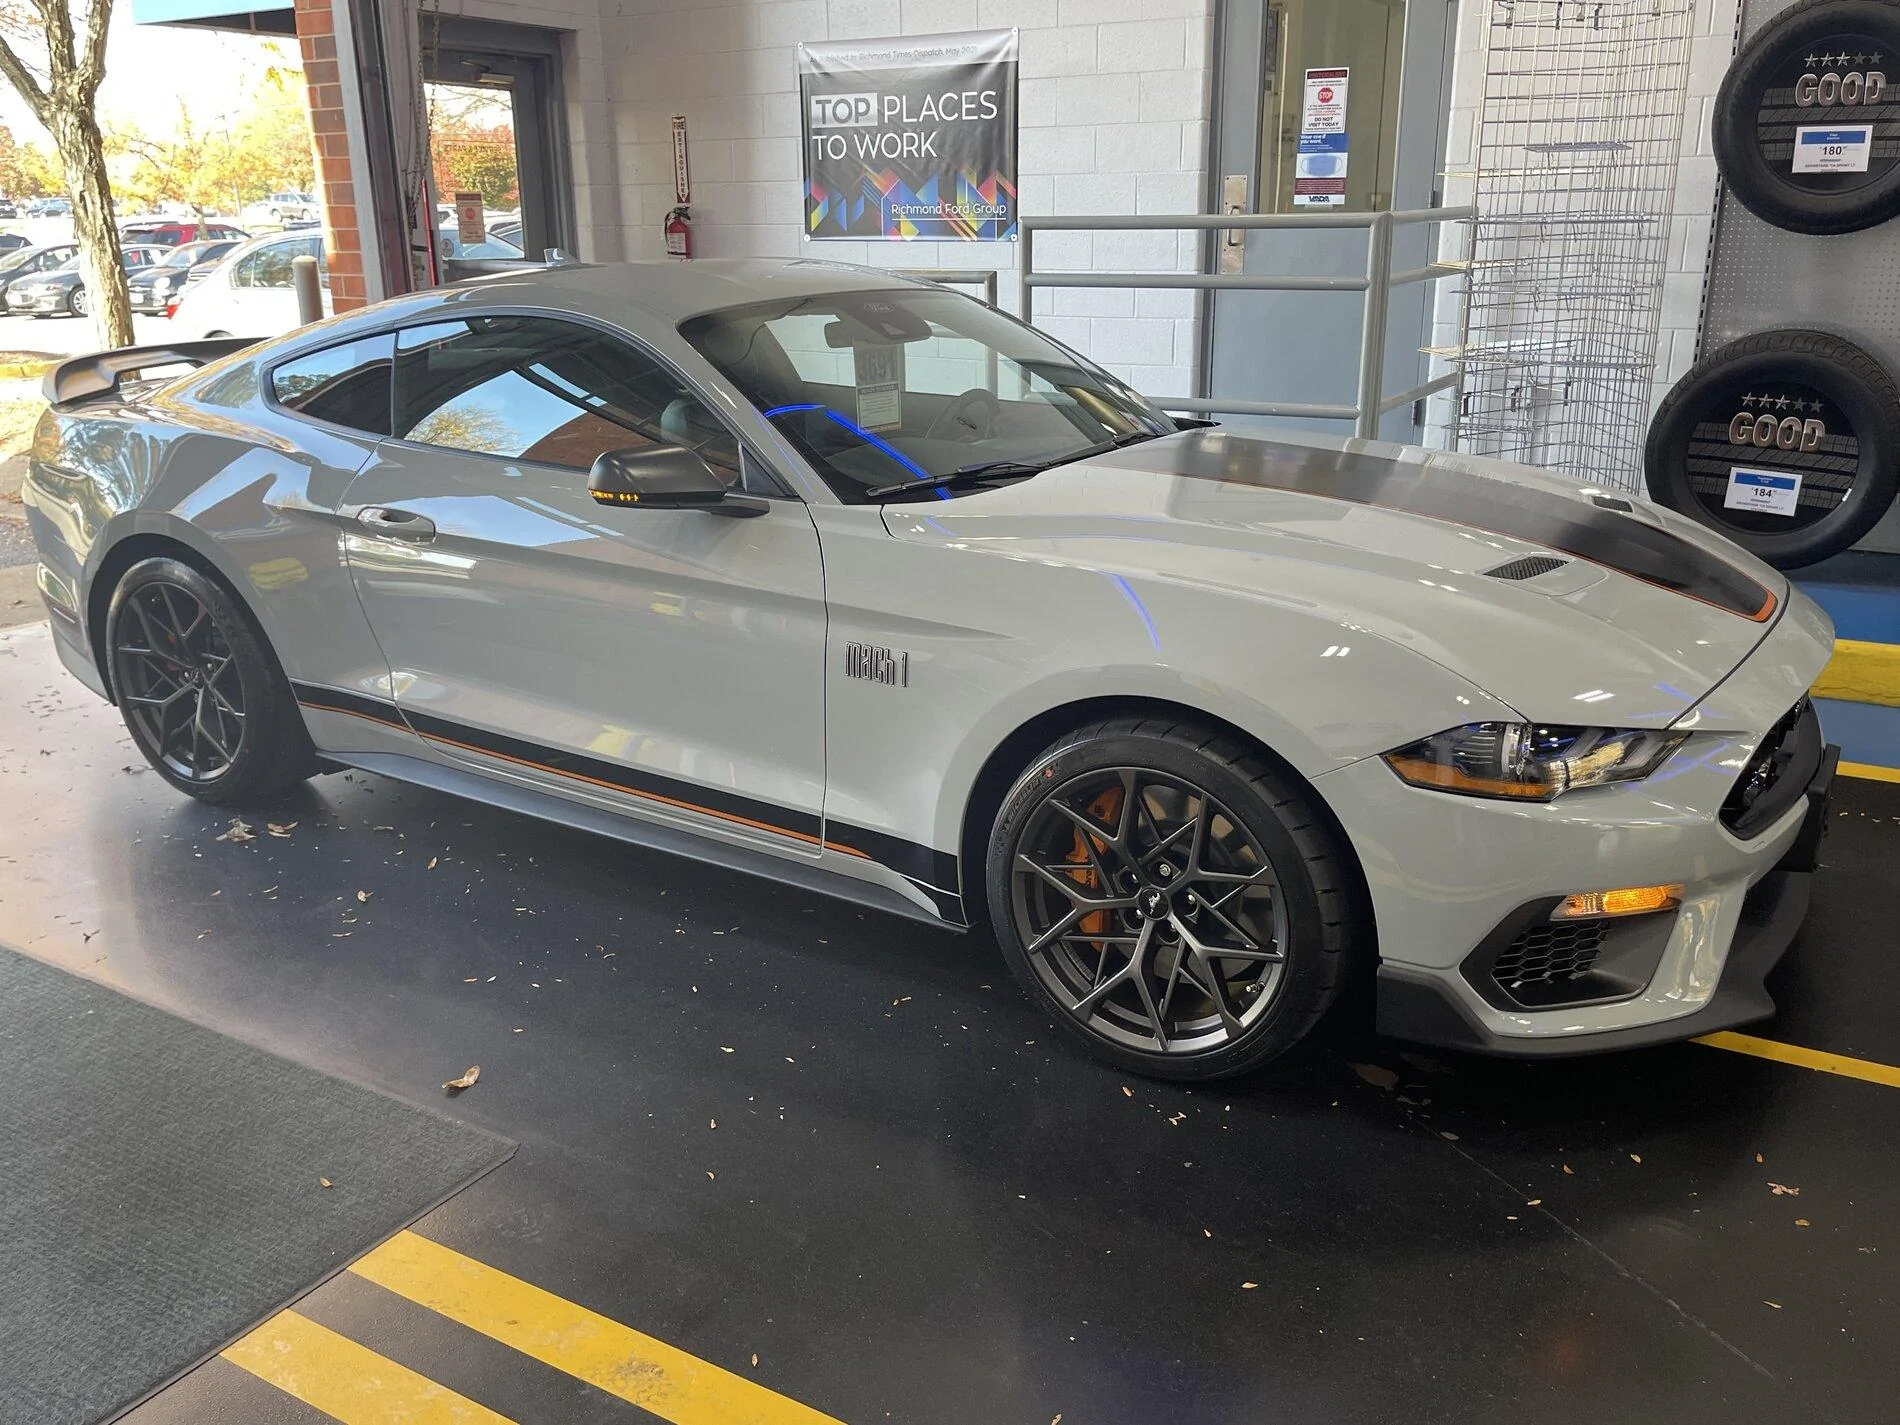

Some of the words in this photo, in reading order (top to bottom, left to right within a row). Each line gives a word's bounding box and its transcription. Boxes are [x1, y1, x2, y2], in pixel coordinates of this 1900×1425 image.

[859, 51, 891, 61] Richmond
[945, 47, 960, 56] May
[1319, 91, 1333, 100] STOP
[1795, 71, 1887, 107] GOOD
[815, 98, 871, 125] TOP
[884, 90, 998, 124] PLACES
[673, 121, 685, 130] FIRE
[812, 134, 847, 160] TO
[853, 131, 938, 159] WORK
[891, 203, 943, 215] Richmond
[945, 203, 969, 215] Ford
[972, 203, 1007, 216] Group
[1729, 412, 1826, 452] GOOD
[901, 651, 908, 688] 1
